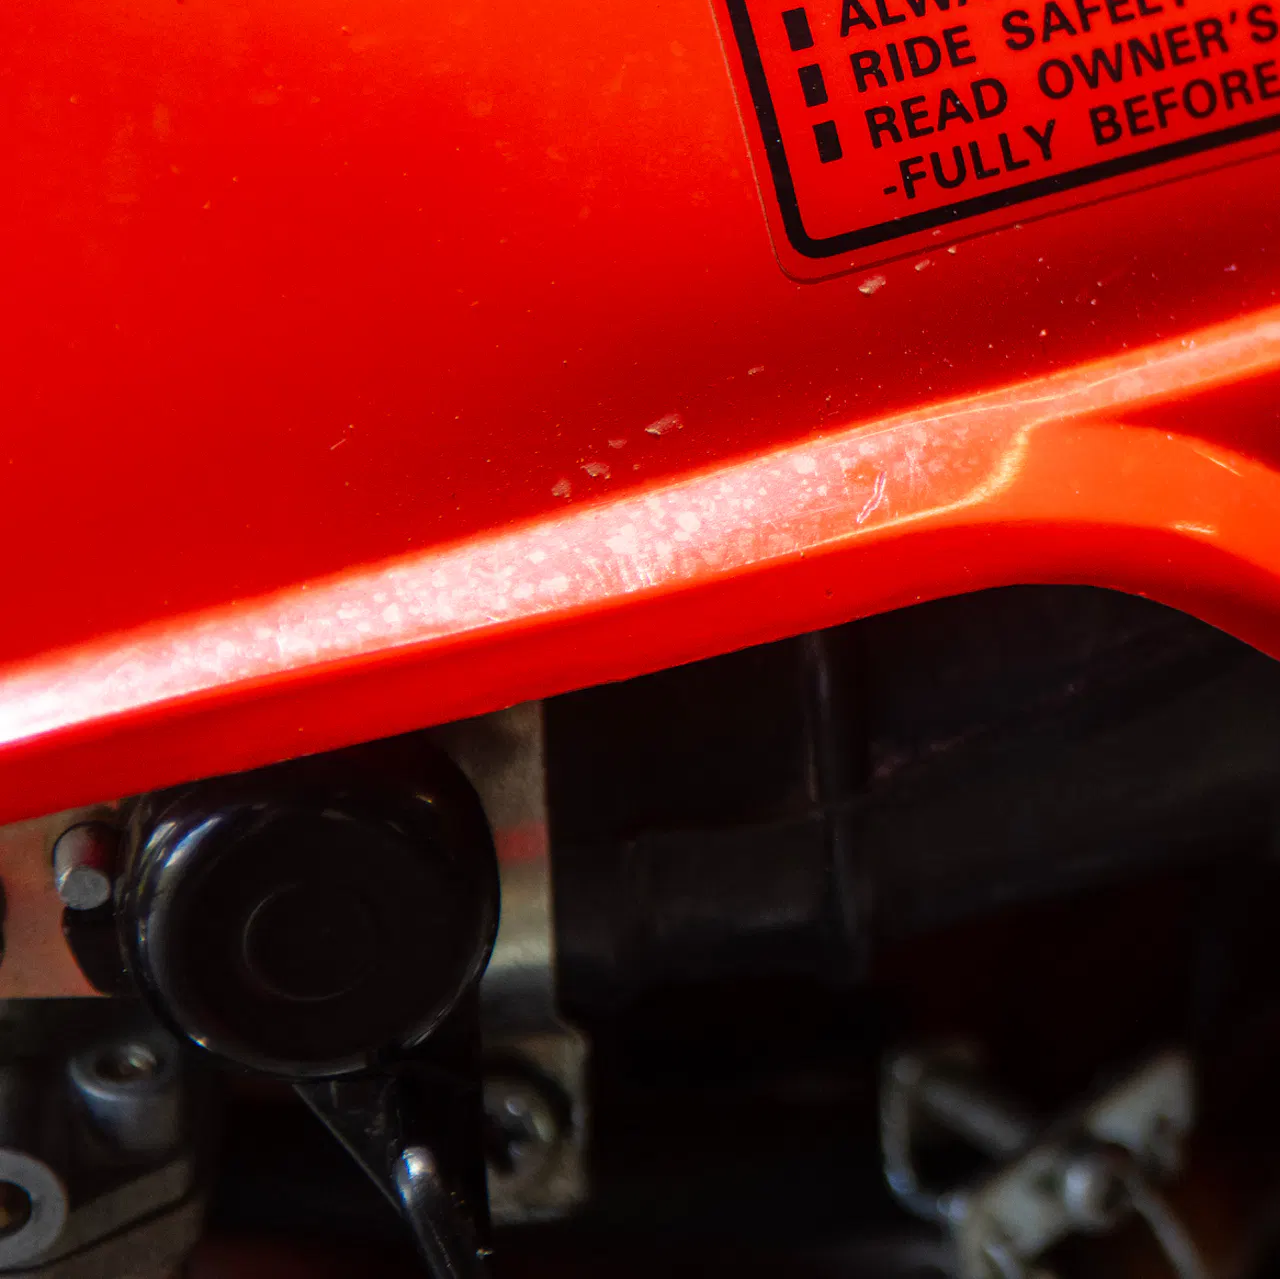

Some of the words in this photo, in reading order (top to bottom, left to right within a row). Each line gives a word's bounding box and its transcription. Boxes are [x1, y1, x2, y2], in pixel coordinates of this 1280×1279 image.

[850, 24, 978, 93] RIDE
[864, 77, 1008, 150] READ
[1037, 4, 1279, 100] OWNER'S
